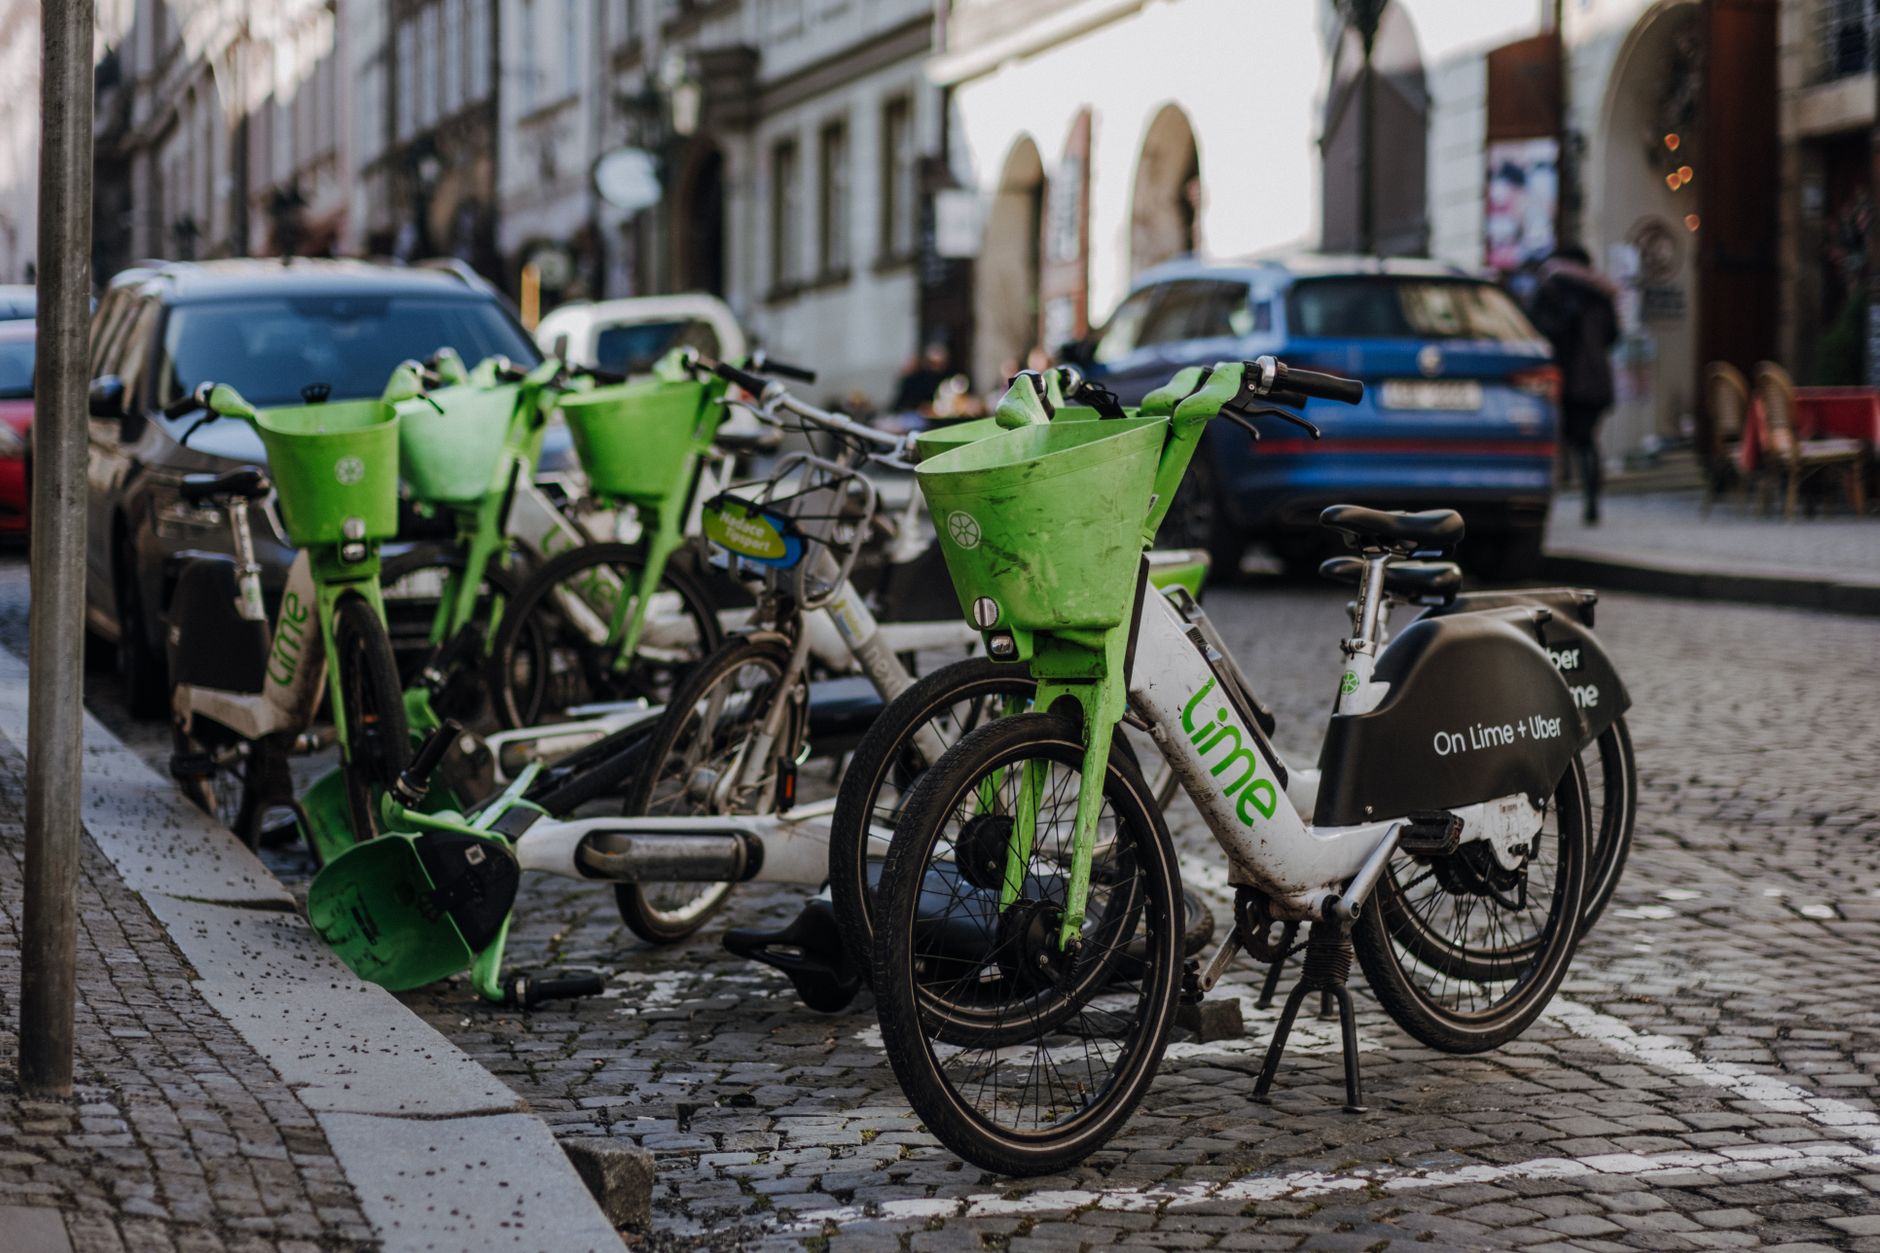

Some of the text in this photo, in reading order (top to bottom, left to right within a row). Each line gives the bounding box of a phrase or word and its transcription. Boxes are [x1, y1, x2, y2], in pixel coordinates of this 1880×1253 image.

[267, 591, 309, 687] Lime
[1545, 646, 1580, 671] ber
[1568, 683, 1600, 709] me
[1182, 675, 1278, 828] Lime
[1433, 713, 1562, 756] On Lime + Uber
